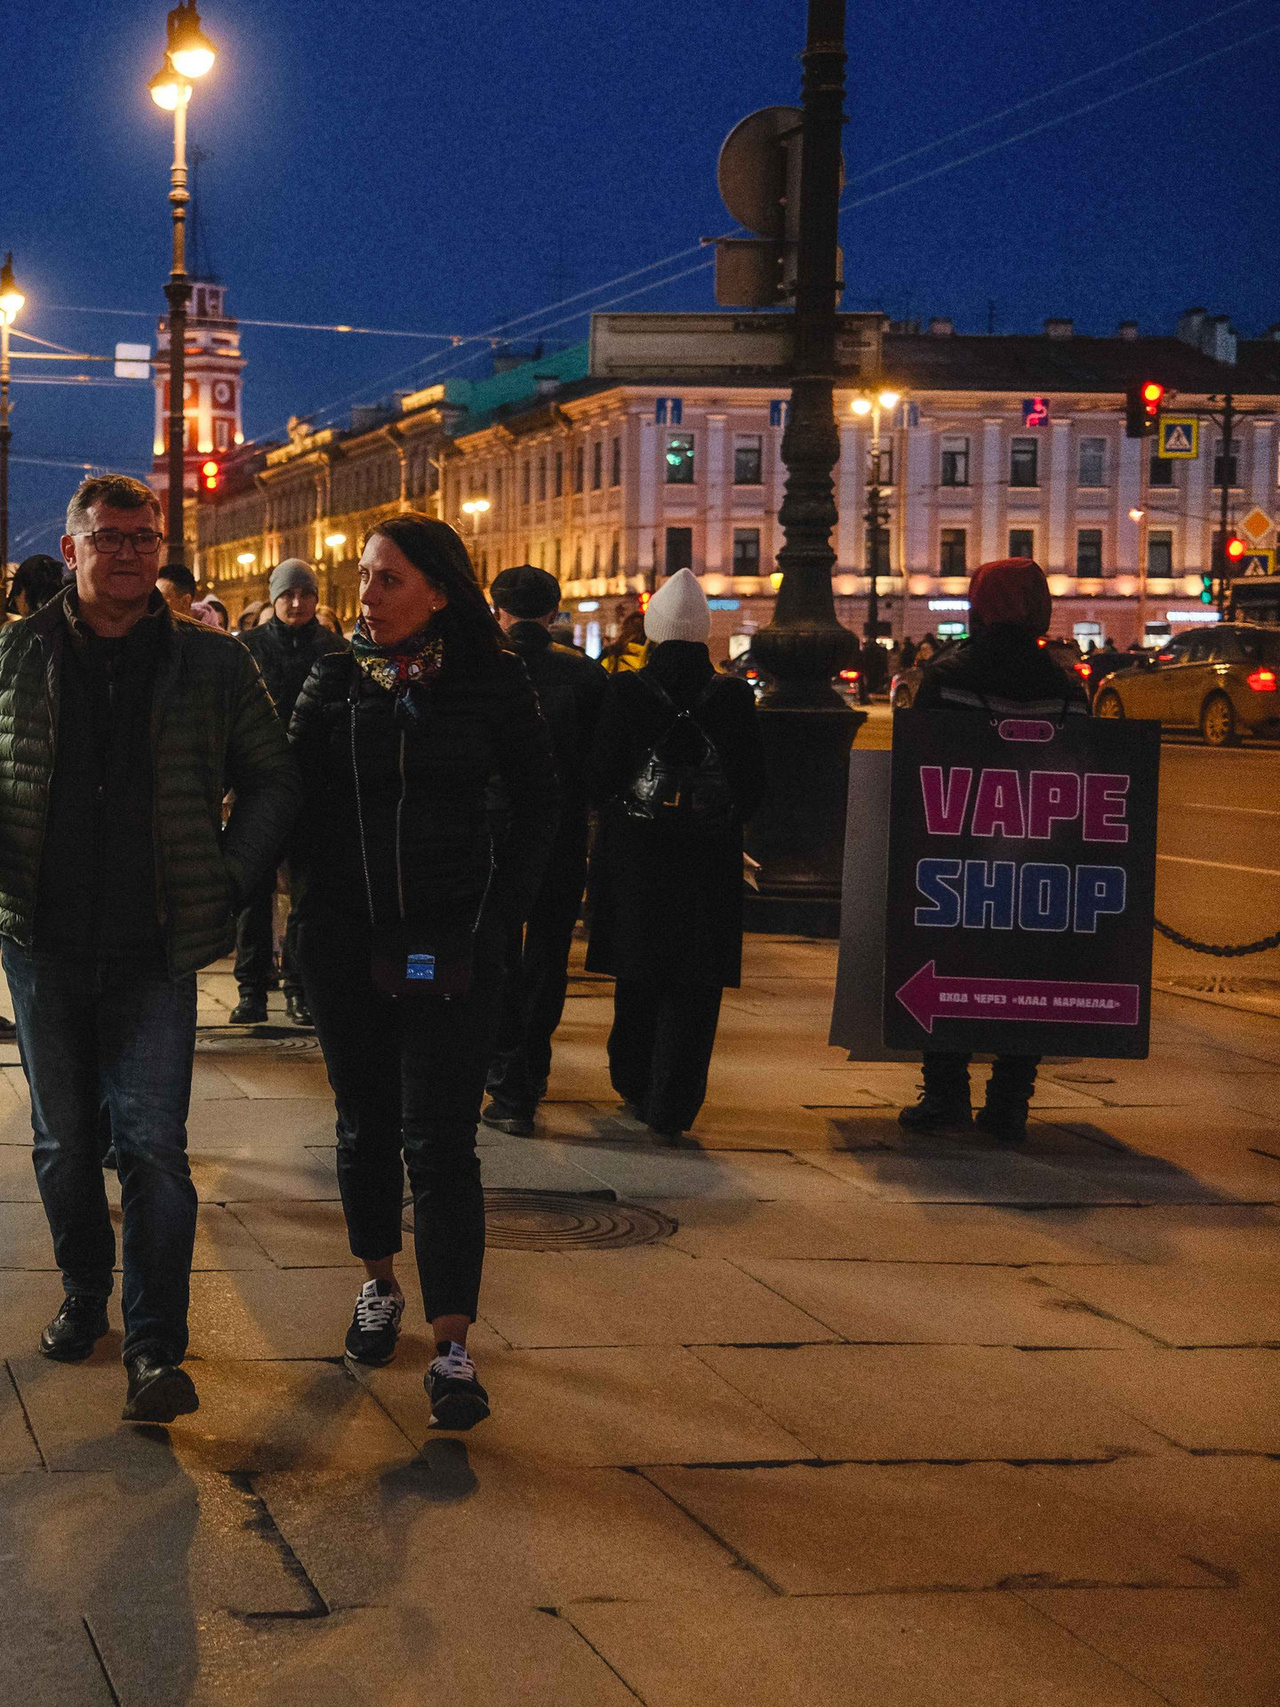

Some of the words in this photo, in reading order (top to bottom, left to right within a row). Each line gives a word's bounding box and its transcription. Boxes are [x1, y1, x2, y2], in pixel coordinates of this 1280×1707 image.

[919, 766, 1130, 842] VAPE
[914, 858, 1126, 933] SHOP
[939, 992, 968, 1003] ВХОД
[974, 994, 1007, 1004] ЧЕРЕЗ
